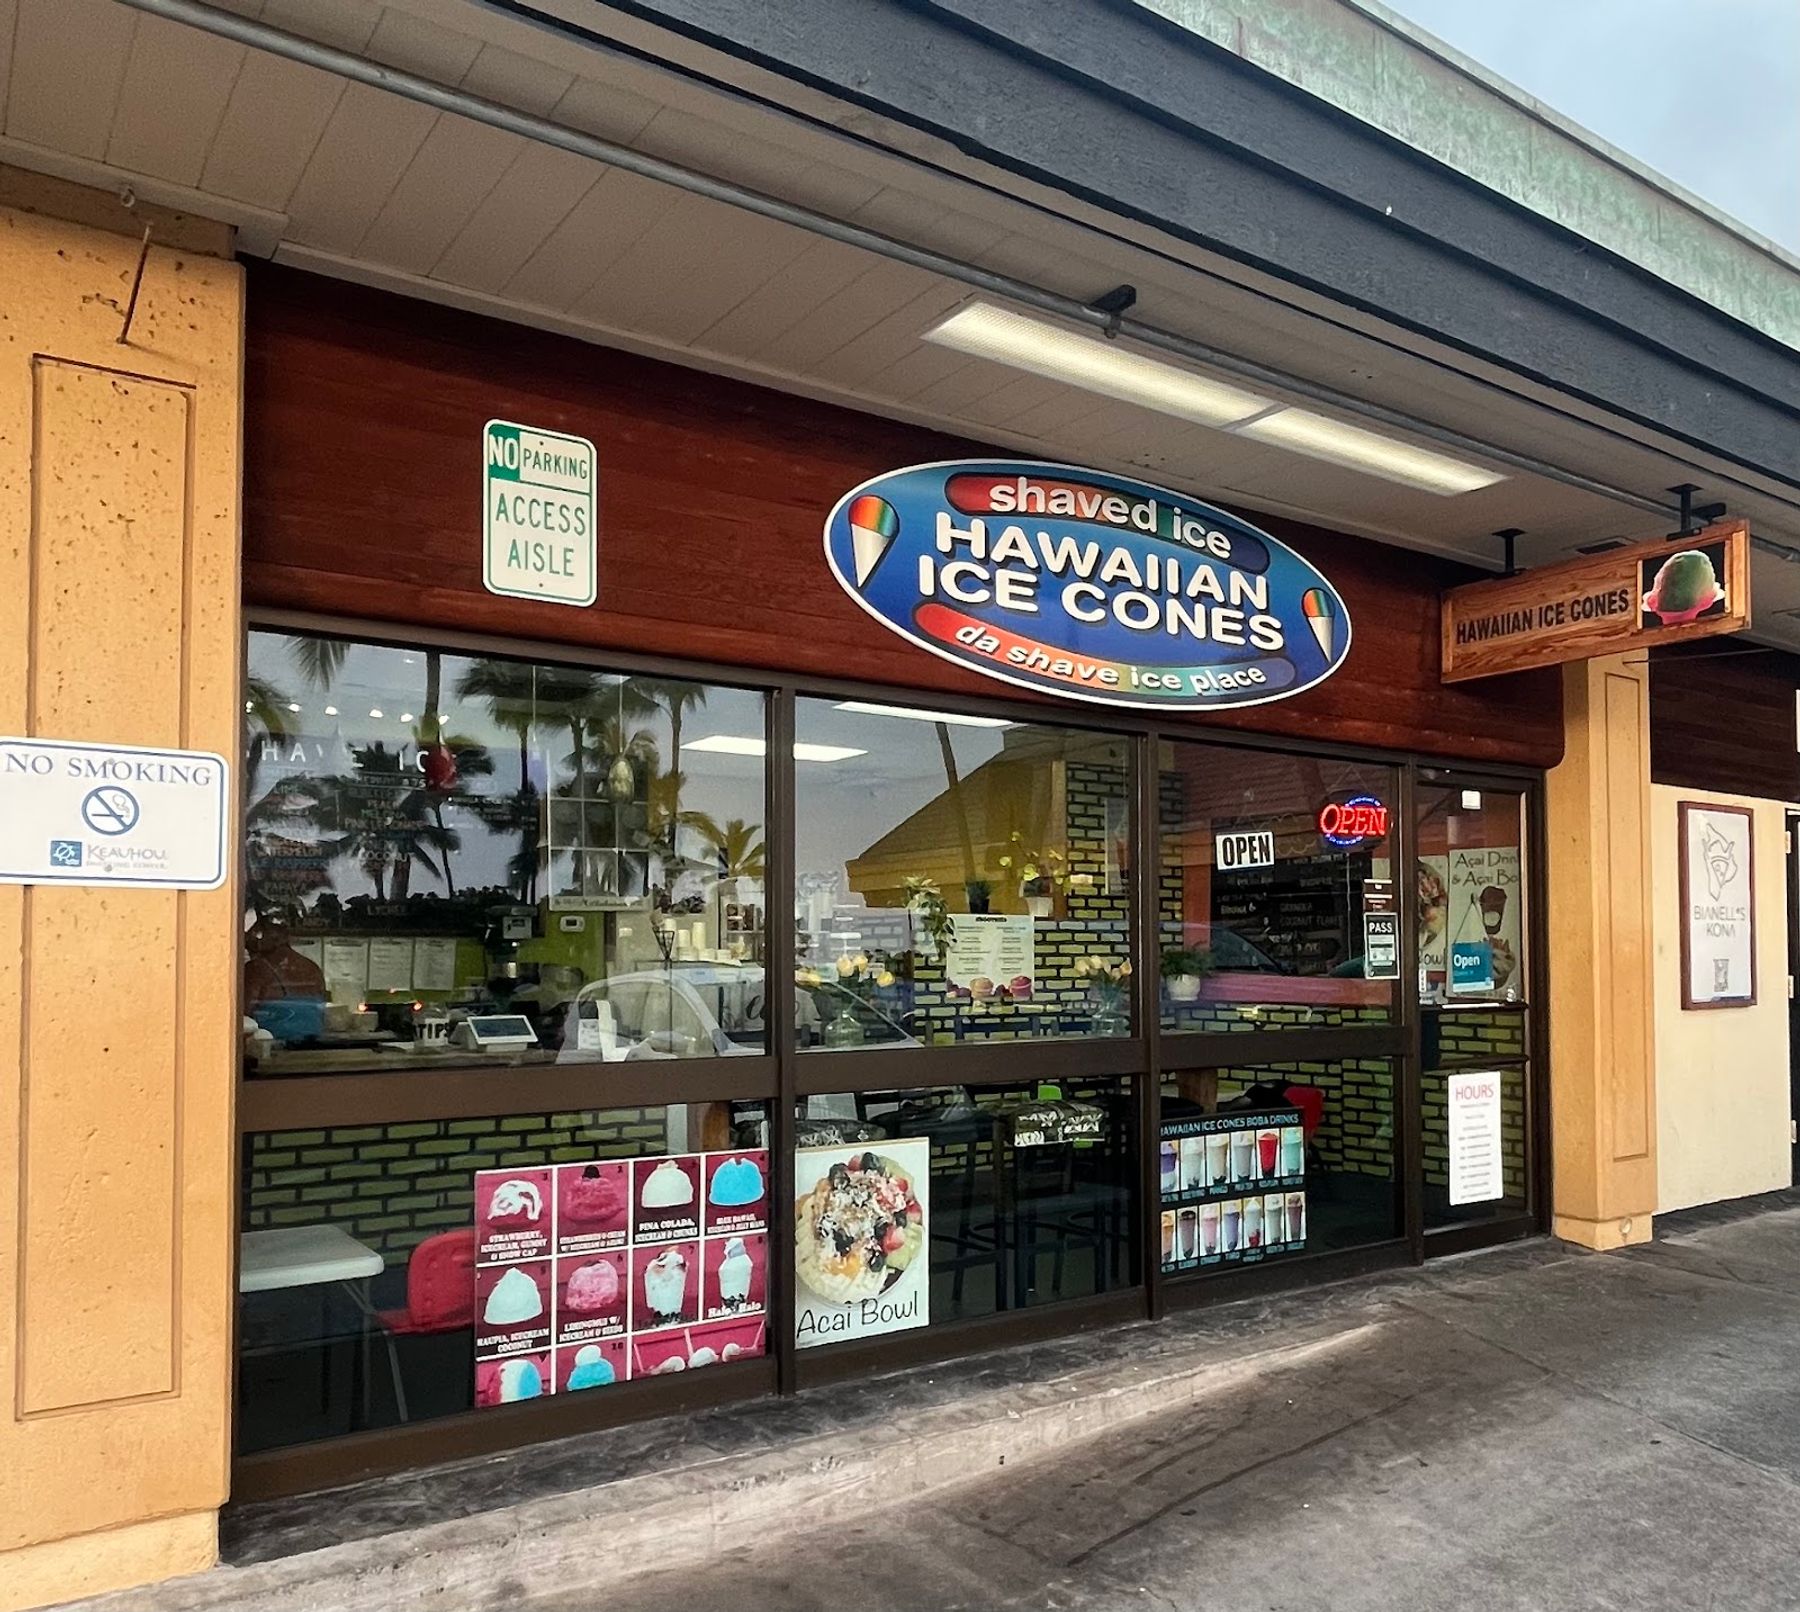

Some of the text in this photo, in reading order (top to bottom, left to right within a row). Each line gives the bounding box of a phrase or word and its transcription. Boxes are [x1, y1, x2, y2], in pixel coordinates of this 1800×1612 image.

[489, 434, 588, 480] NO PARKING
[495, 492, 586, 536] ACCESS
[989, 477, 1231, 559] shaved ice
[507, 538, 574, 577] AISLE
[936, 511, 1267, 610] HAWAIIAN
[919, 554, 1285, 651] ICE CONES
[1456, 588, 1629, 644] HAWAIIAN ICE CONES
[955, 623, 1267, 694] da shave ice place
[6, 753, 211, 786] NO SMOKING
[1320, 803, 1387, 836] OPEN
[1222, 834, 1271, 866] OPEN
[1369, 922, 1392, 934] PASS
[1706, 923, 1736, 937] KONA
[1453, 954, 1481, 969] Open
[1455, 1084, 1494, 1100] HOURS
[1202, 1119, 1216, 1131] ICE
[1217, 1117, 1245, 1130] CONES
[1246, 1115, 1269, 1128] BOBA
[1270, 1113, 1299, 1125] DRINKS
[522, 1248, 538, 1257] CAP
[796, 1290, 918, 1339] Acai Bowl
